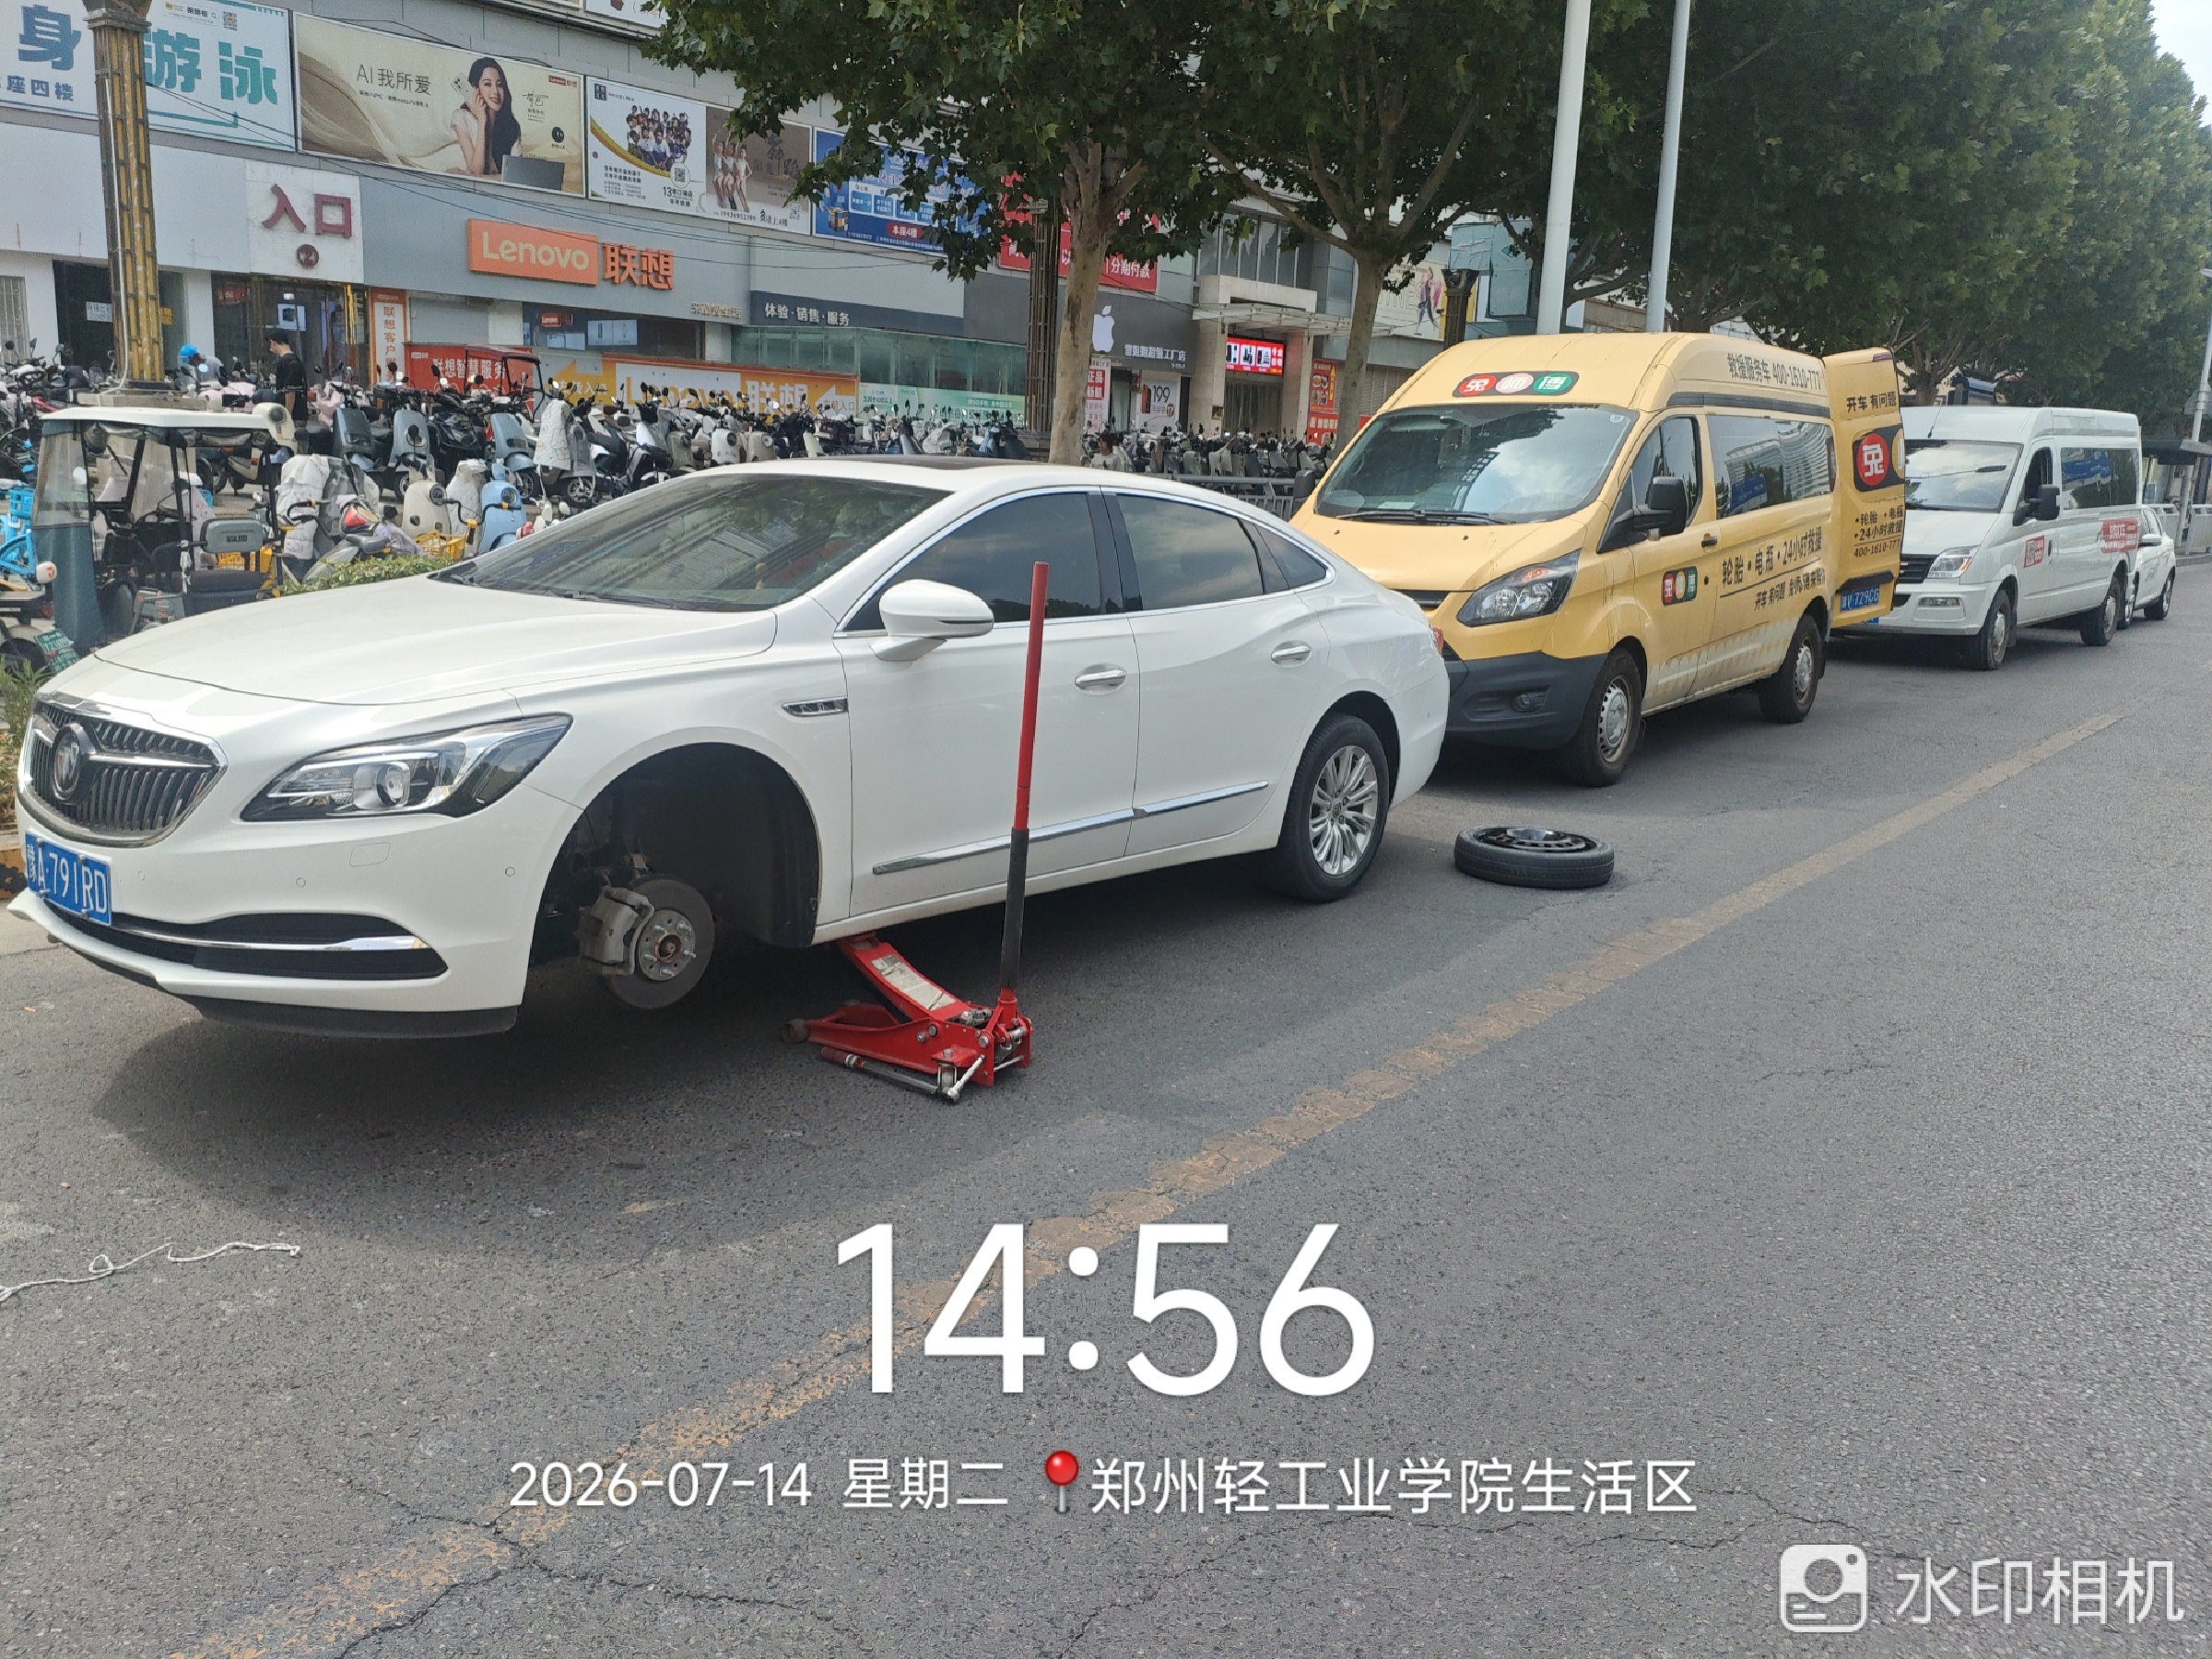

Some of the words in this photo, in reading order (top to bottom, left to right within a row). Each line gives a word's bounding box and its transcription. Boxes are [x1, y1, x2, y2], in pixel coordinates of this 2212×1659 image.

[18, 5, 81, 71] 身
[145, 27, 277, 105] 游泳
[0, 75, 74, 101] 座四楼
[262, 183, 353, 240] 入口
[482, 231, 590, 271] Lenovo
[603, 241, 675, 290] 联想
[1846, 394, 1867, 413] 开车
[1870, 391, 1897, 408] 有问题
[1853, 539, 1900, 558] 400-1610-777
